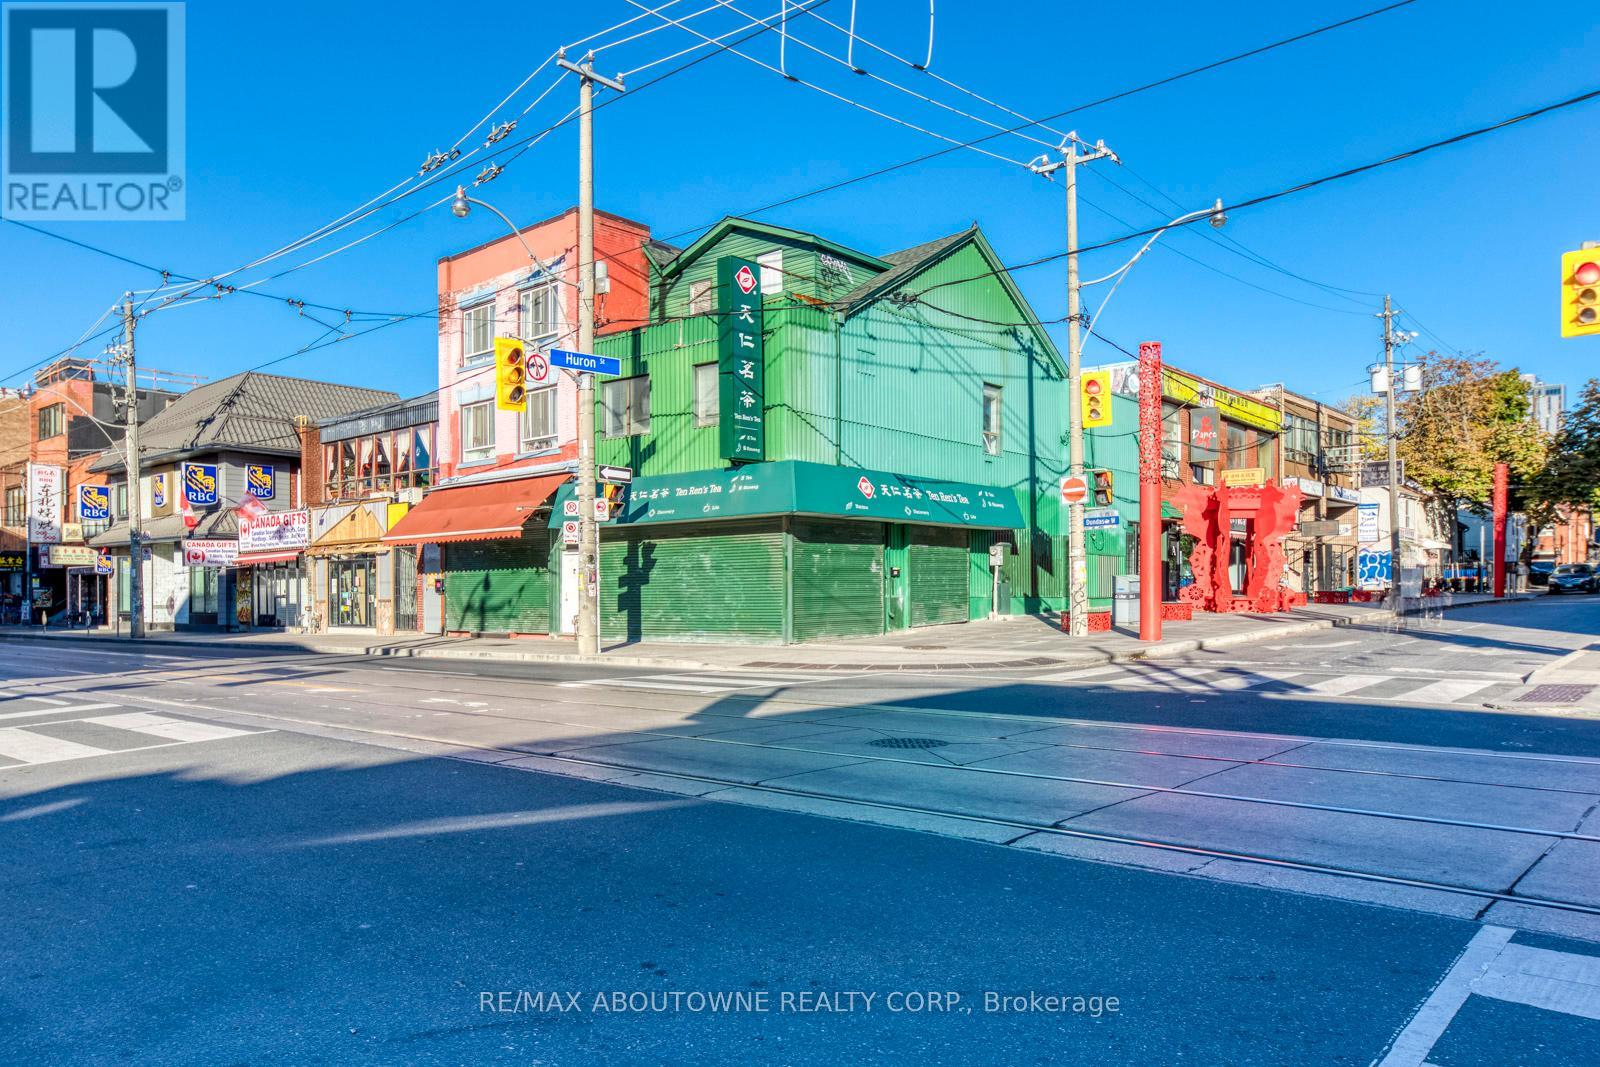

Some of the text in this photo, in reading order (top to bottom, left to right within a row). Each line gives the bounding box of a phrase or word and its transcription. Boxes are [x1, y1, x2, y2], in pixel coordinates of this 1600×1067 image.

[565, 353, 596, 368] Huron
[188, 491, 214, 502] RBC
[250, 487, 271, 497] RBC
[675, 484, 722, 497] Ten Ren's Tea
[880, 484, 922, 500] 天仁茗茶
[926, 490, 969, 505] Ten Ren's Tea
[83, 509, 107, 518] RBC
[251, 512, 307, 530] CANADA GIFTS
